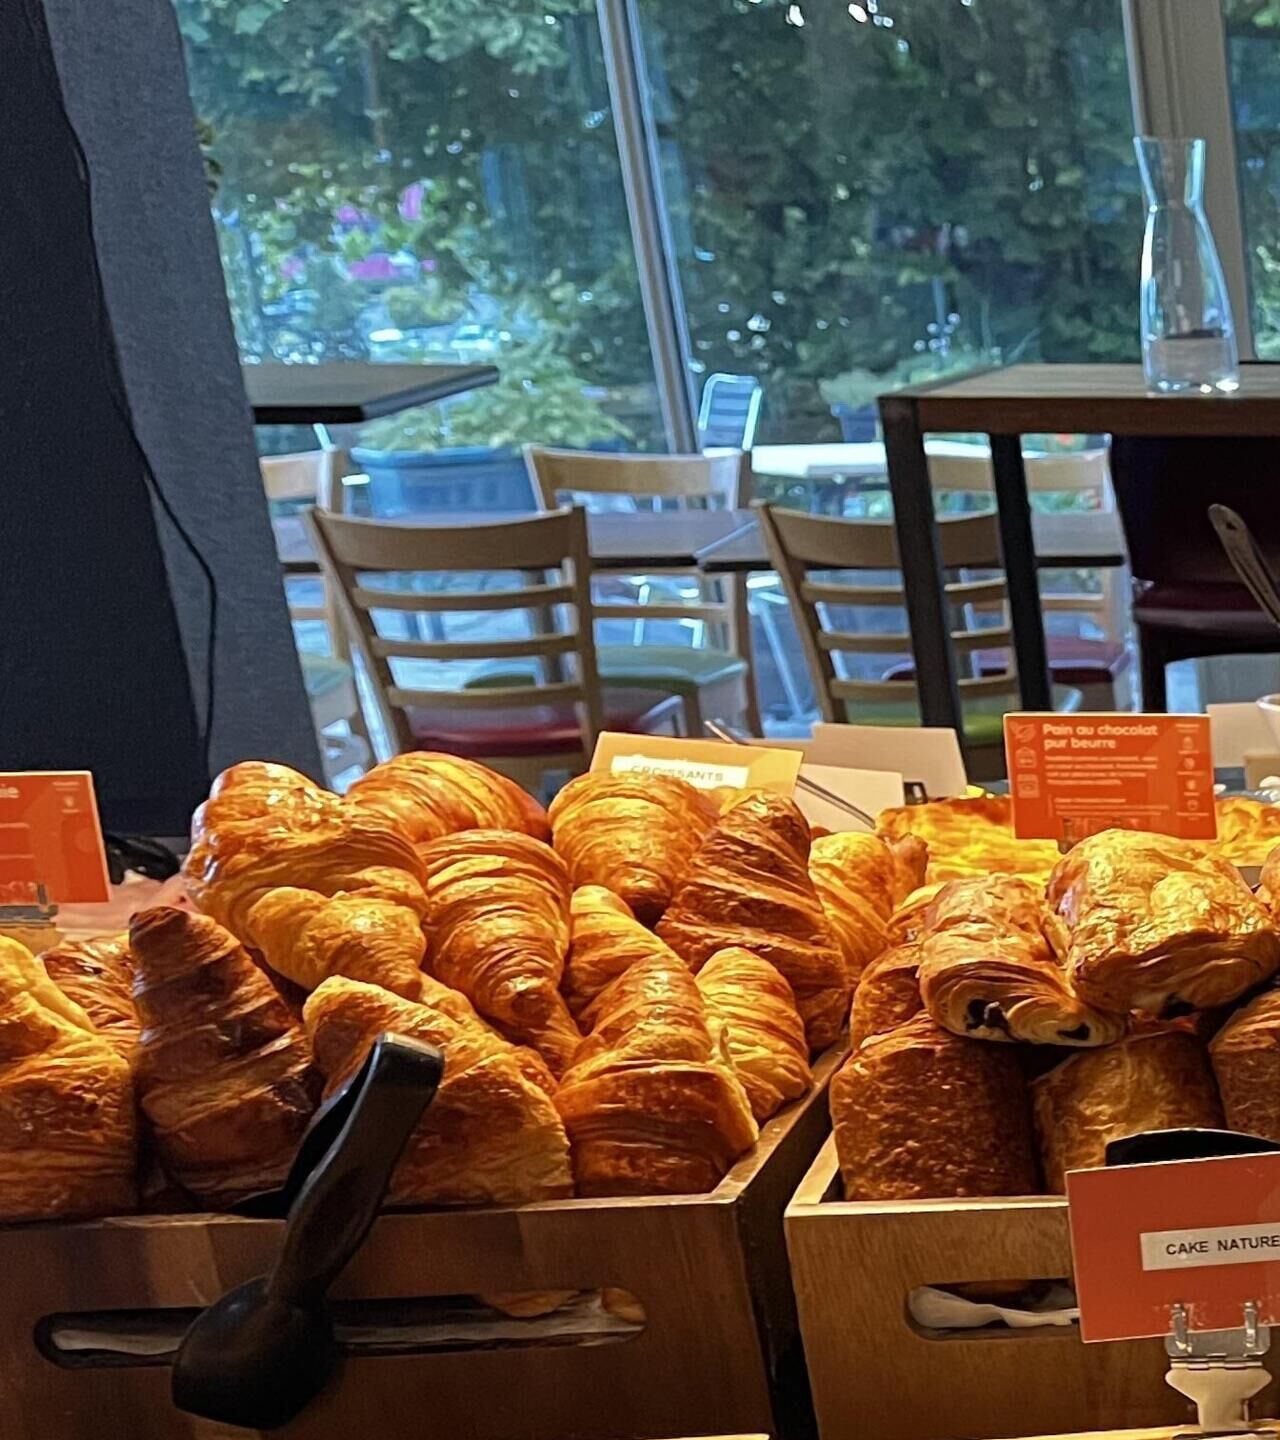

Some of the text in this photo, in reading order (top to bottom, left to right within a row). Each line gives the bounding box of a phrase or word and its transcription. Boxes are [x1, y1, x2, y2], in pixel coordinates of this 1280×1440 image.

[1042, 723, 1158, 736] Pain au chocolat
[1044, 737, 1116, 751] pur beurre
[1166, 1235, 1280, 1256] CAKE NATURE
